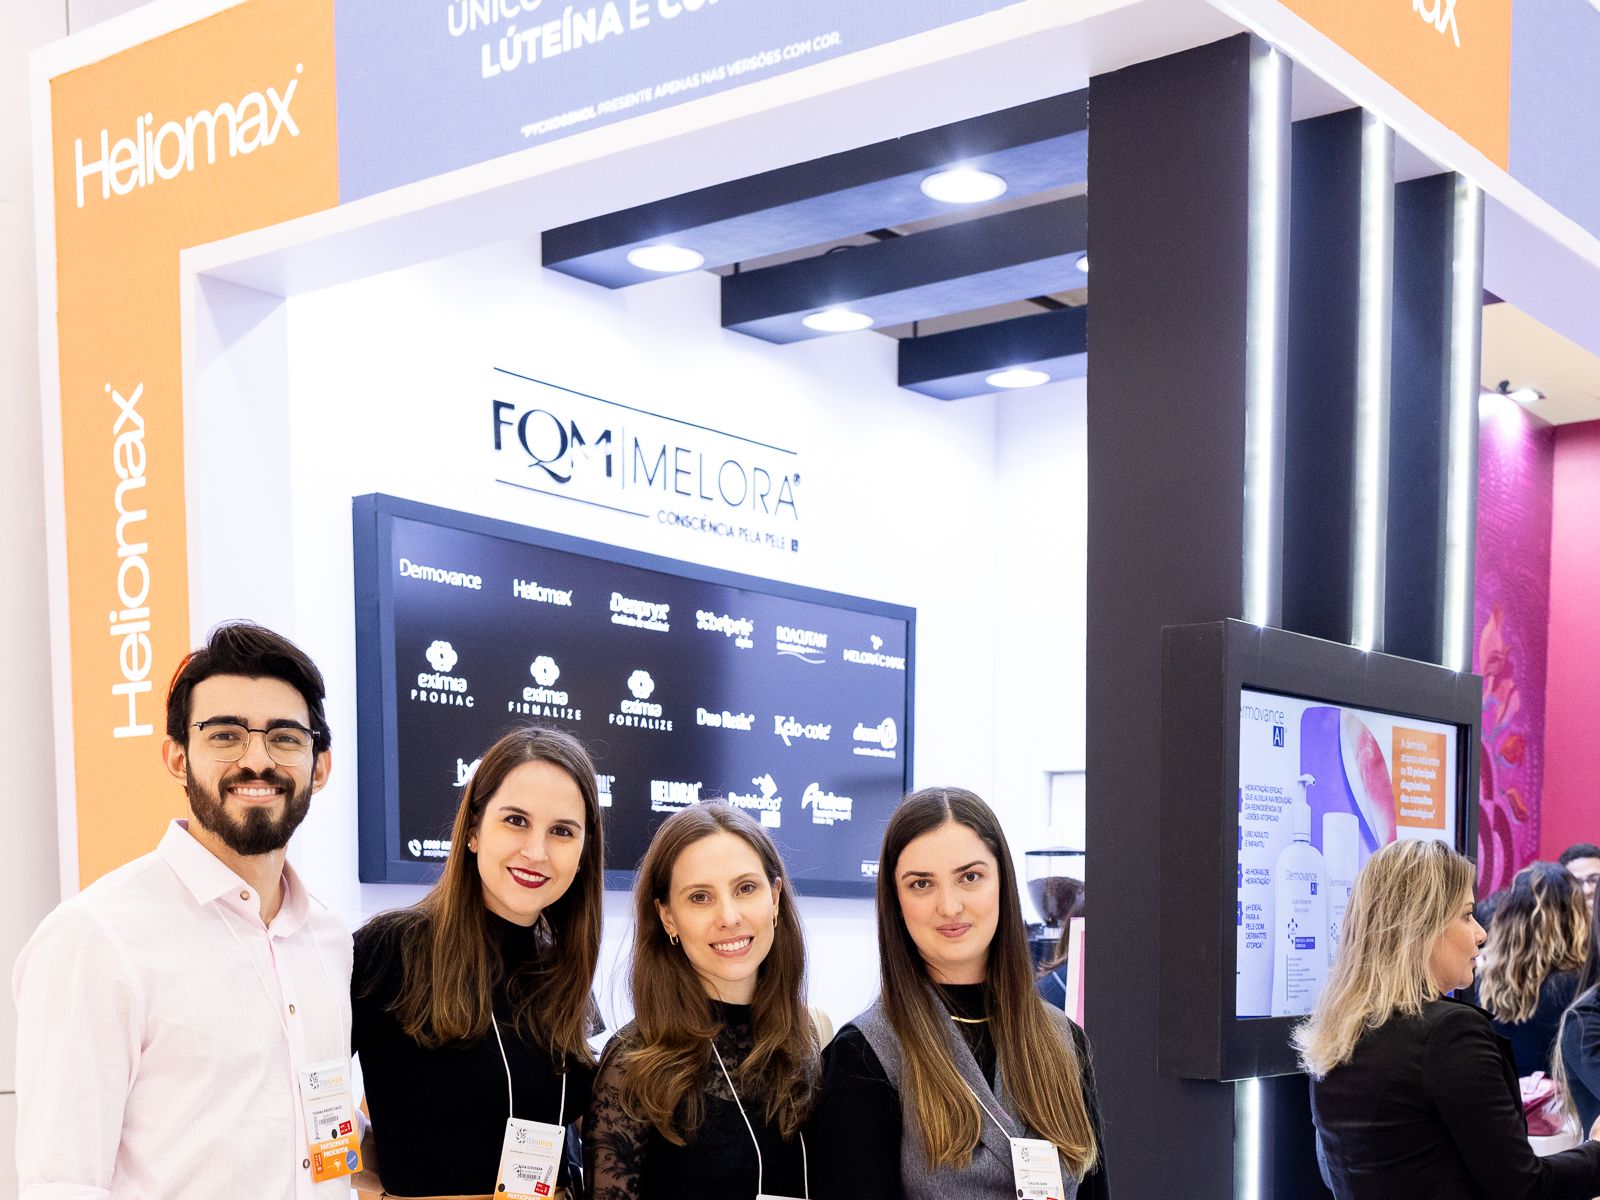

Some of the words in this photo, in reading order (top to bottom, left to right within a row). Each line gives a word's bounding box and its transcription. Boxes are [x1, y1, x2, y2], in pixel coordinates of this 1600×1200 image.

[481, 1, 625, 79] LÚTEÍNA
[629, 0, 650, 30] E
[597, 88, 653, 115] PRESENTE
[654, 73, 701, 99] APENAS
[701, 65, 726, 85] NAS
[726, 50, 782, 78] VERSÕES
[783, 41, 812, 60] COM
[75, 78, 301, 208] Heliomax
[493, 399, 612, 484] FQM
[633, 437, 798, 521] MELORA
[109, 382, 154, 738] Heliomax
[739, 527, 761, 544] PELA
[766, 533, 785, 550] PELE
[399, 558, 482, 590] Dermovance
[411, 689, 475, 708] PROBIAC
[508, 701, 582, 721] FIRMALIZE
[608, 713, 673, 732] FORTALIZE
